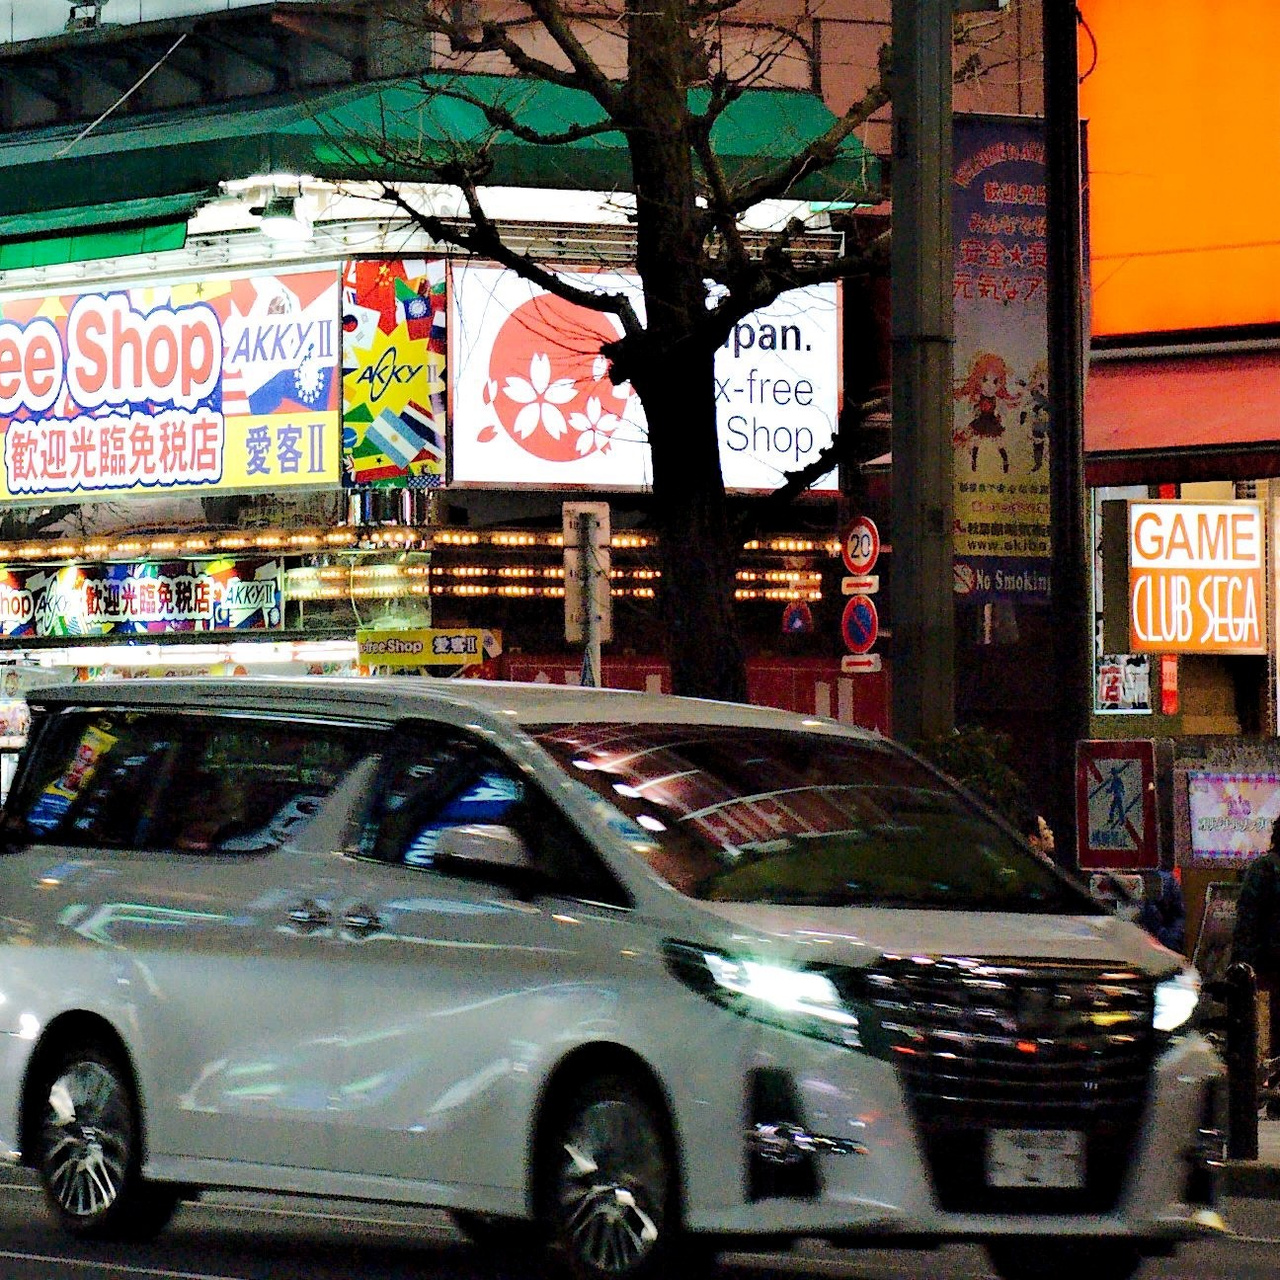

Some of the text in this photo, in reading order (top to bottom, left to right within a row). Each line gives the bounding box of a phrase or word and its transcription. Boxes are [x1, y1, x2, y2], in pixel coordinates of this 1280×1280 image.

[74, 308, 216, 396] Shop
[231, 320, 313, 363] AKKY
[10, 421, 219, 481] 歓迎光臨免税店
[726, 415, 814, 463] Shop
[850, 533, 871, 559] 20
[1134, 511, 1256, 562] GAME
[976, 568, 992, 591] No
[1132, 574, 1260, 644] CLUB SEGA
[387, 638, 423, 655] Shop
